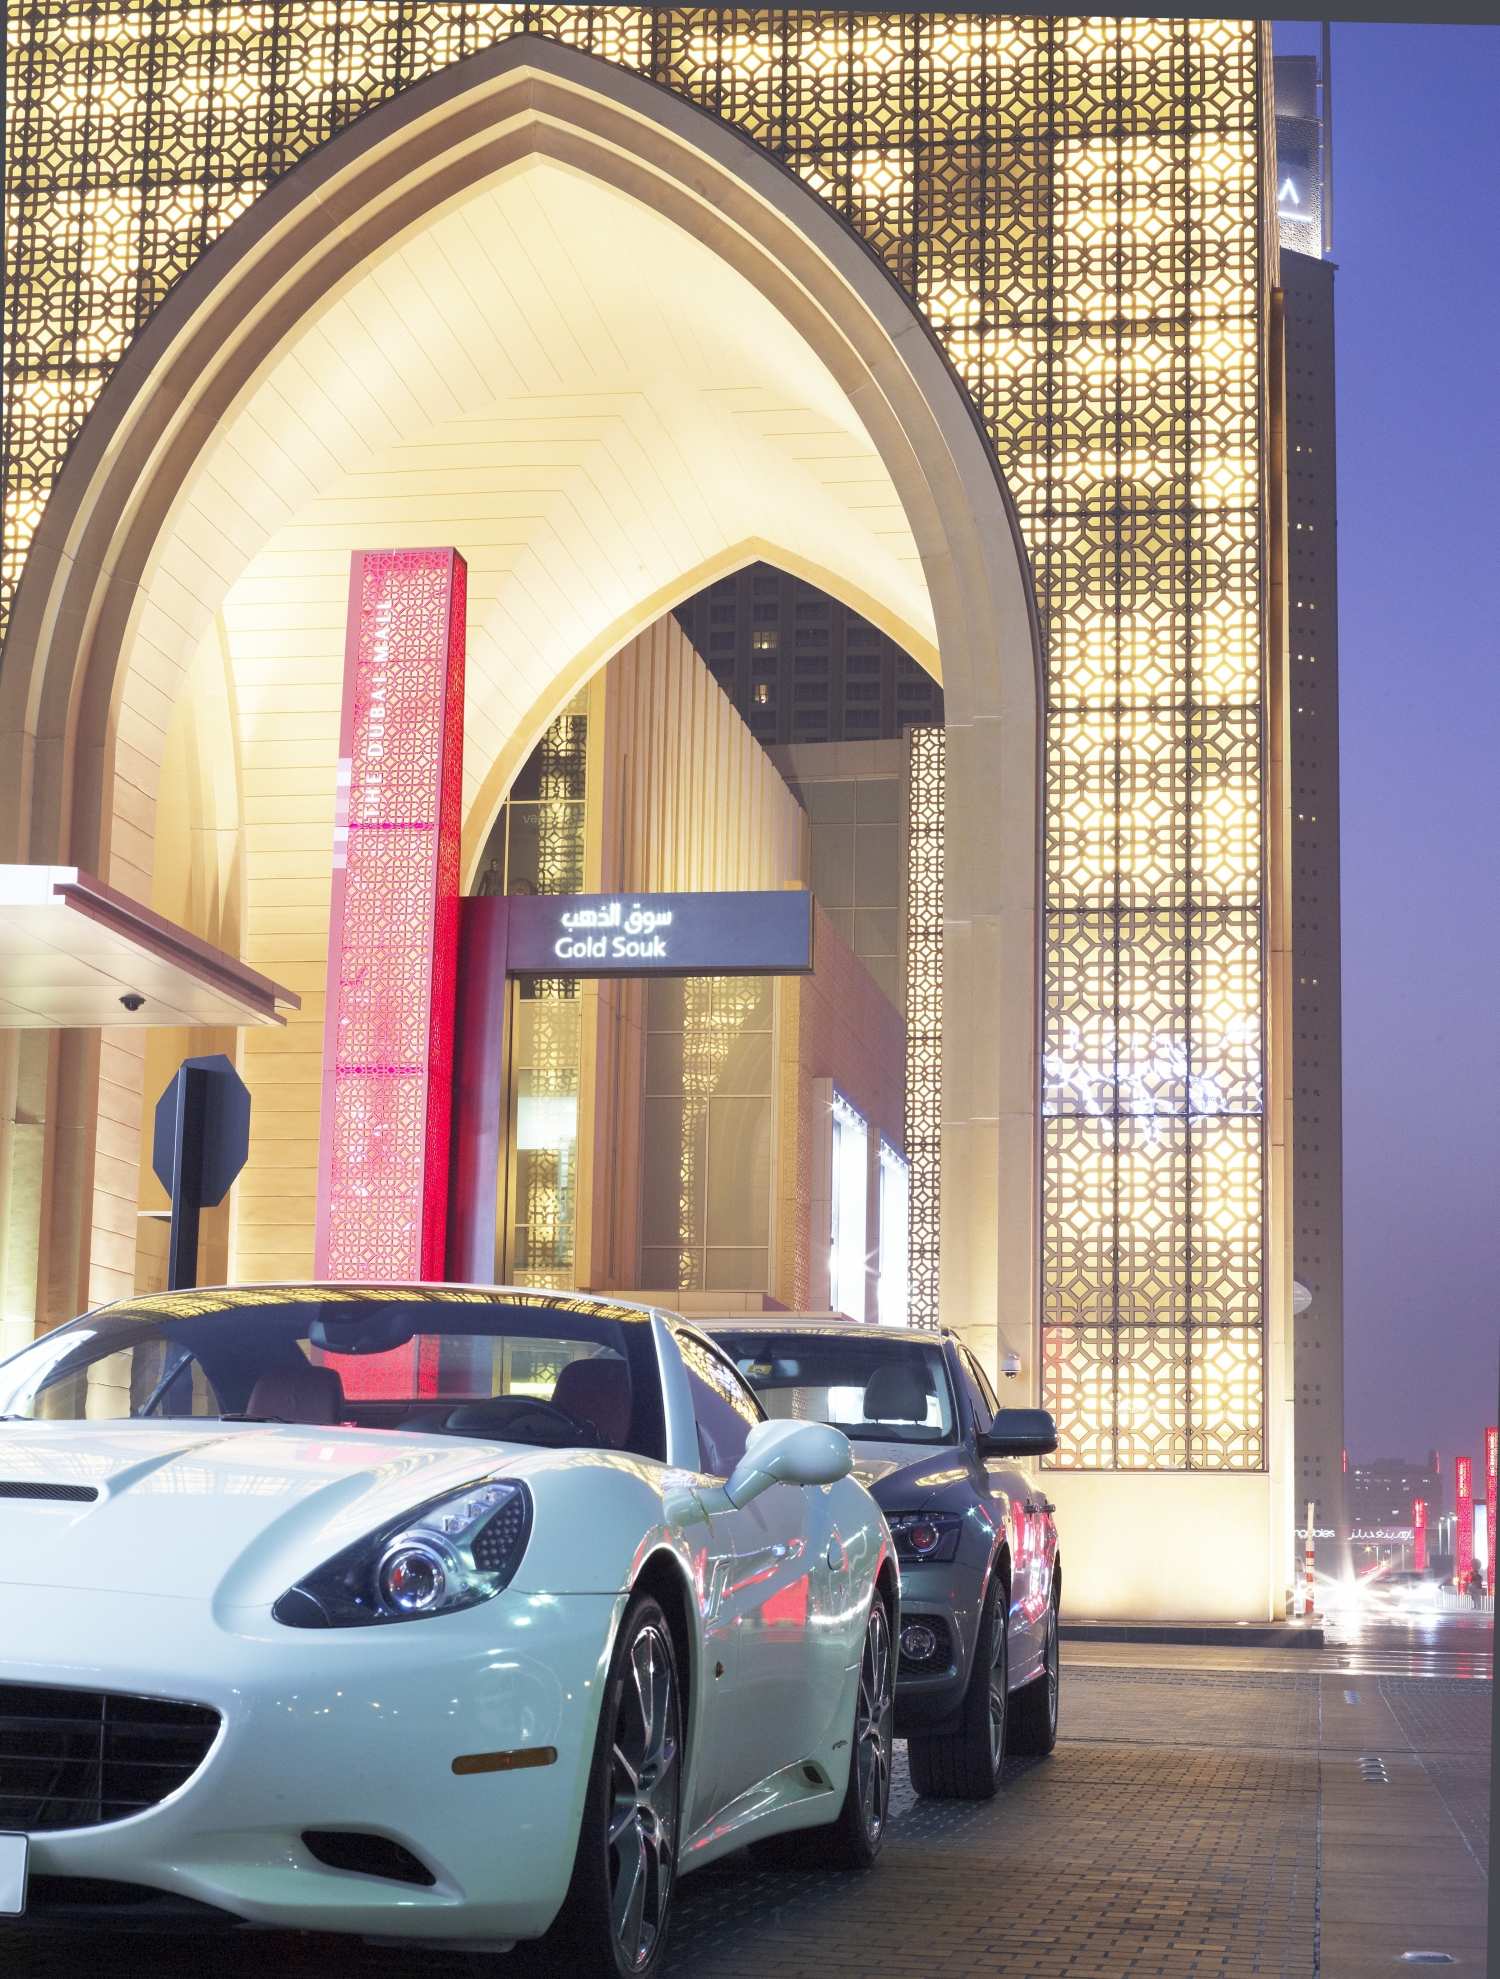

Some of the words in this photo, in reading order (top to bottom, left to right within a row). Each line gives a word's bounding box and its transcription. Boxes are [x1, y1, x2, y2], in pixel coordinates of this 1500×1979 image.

[374, 599, 392, 662] MALL
[367, 676, 388, 758] DUBAI
[363, 771, 384, 822] THE
[562, 903, 621, 932] الذهب
[624, 903, 672, 933] سوق
[555, 937, 606, 958] Gold
[612, 936, 667, 957] Souk
